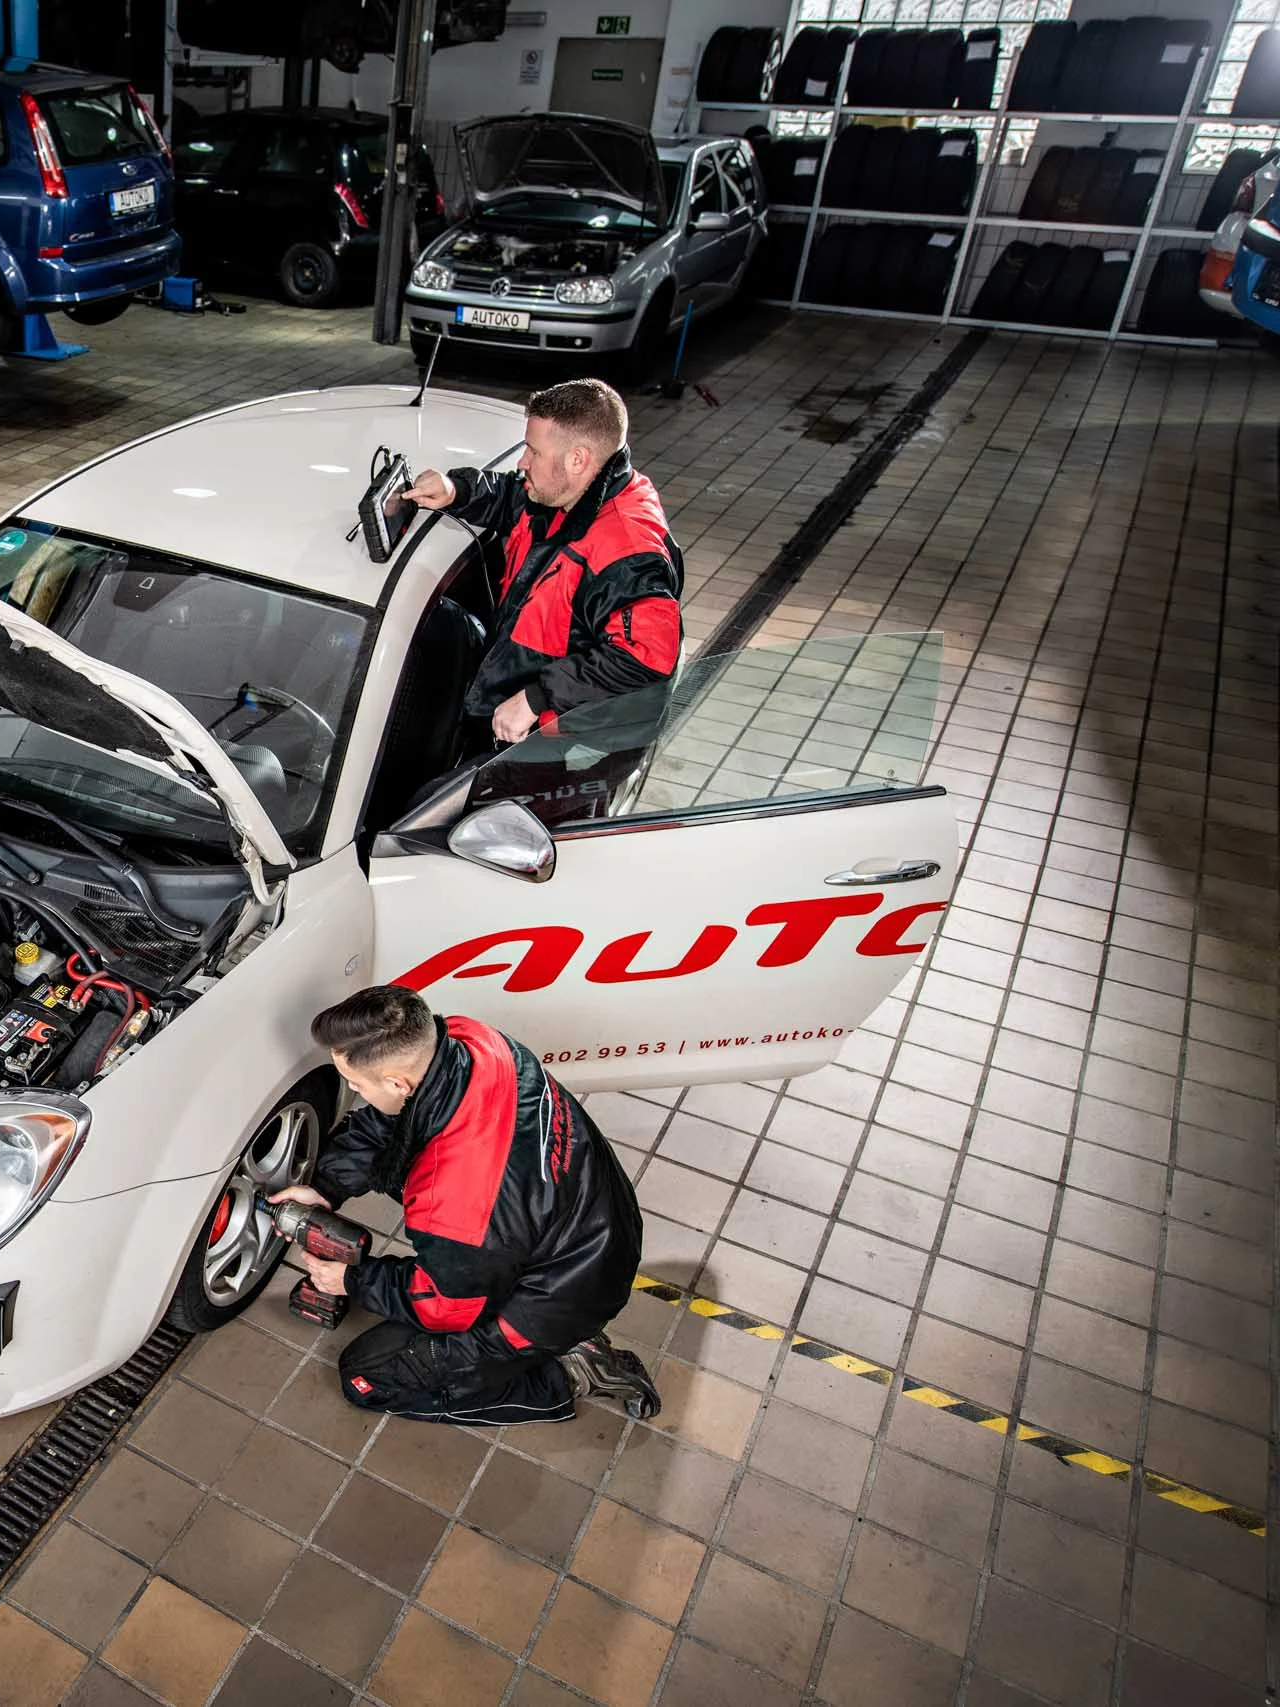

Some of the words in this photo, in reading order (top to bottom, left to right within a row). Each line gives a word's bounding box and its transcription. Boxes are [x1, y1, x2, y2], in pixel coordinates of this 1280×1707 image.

[472, 310, 519, 327] AUTOKO
[542, 1049, 588, 1064] 802
[598, 1046, 627, 1060] 99
[636, 1042, 667, 1055] 53
